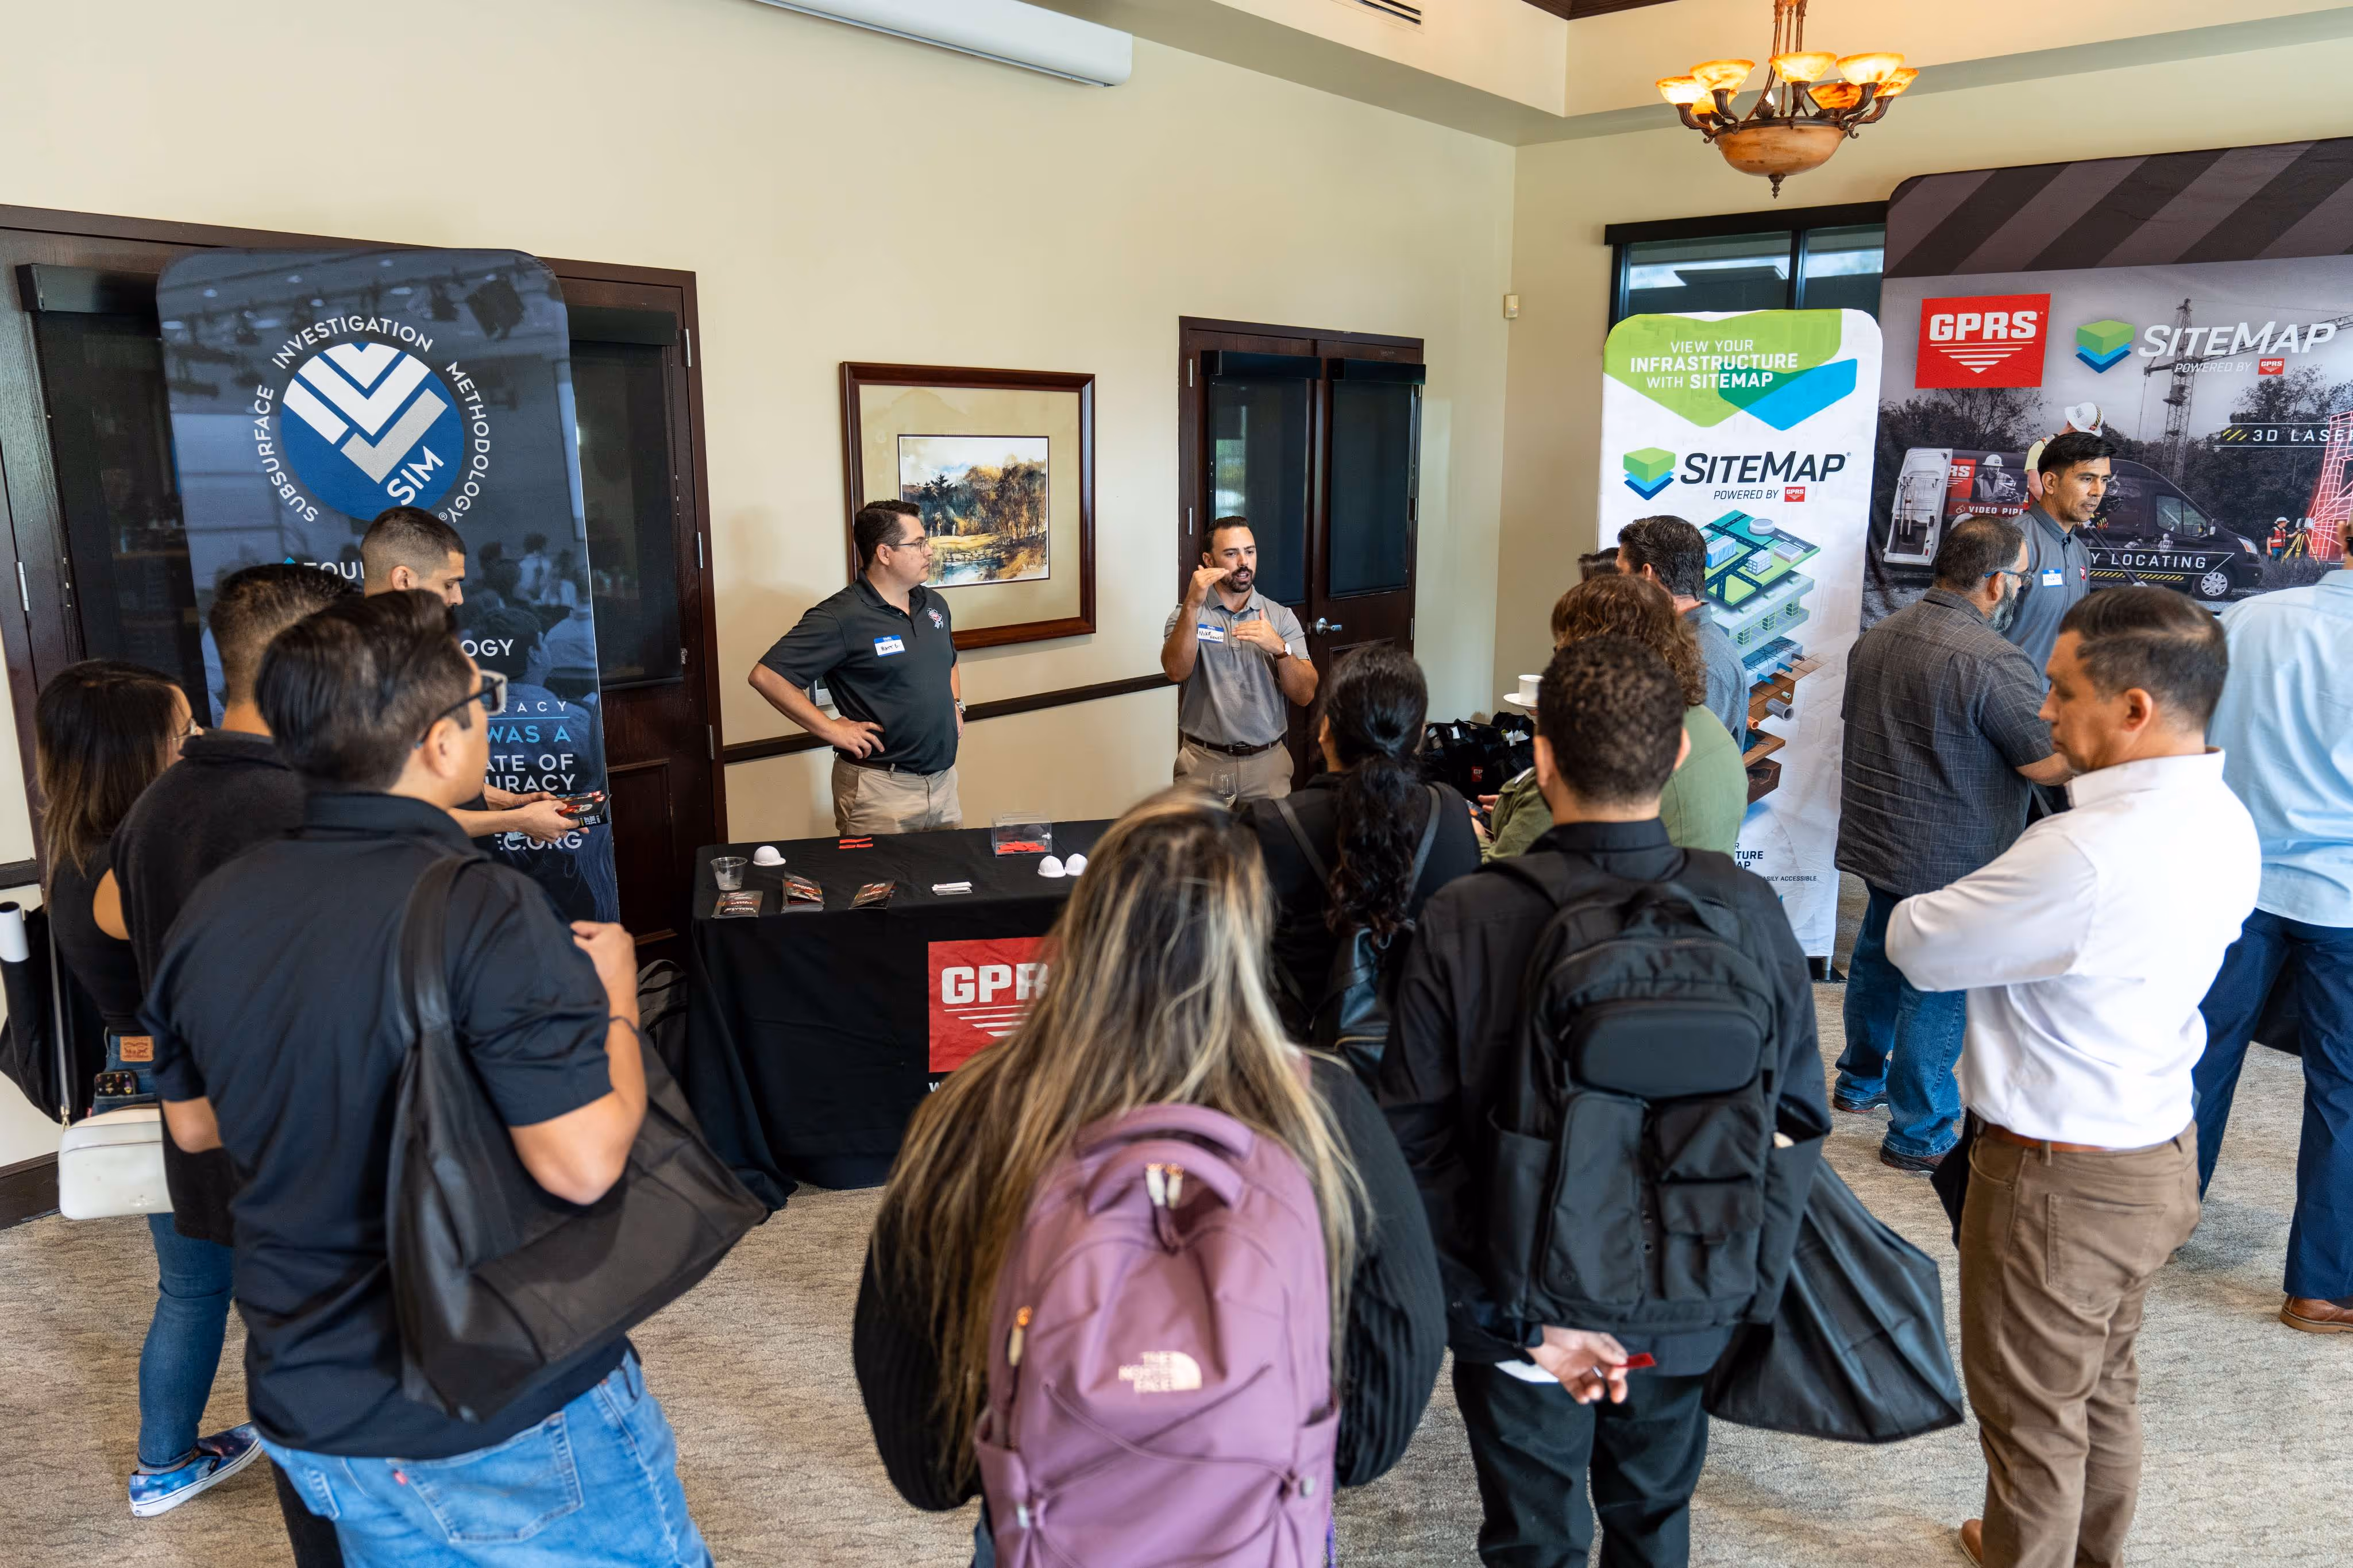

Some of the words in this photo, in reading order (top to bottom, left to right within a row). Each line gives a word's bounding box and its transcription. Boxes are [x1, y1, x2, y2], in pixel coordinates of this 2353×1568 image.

[1929, 311, 2038, 341] GPRS
[272, 315, 433, 369] INVESTIGATION
[1671, 341, 1708, 353] VIEW
[1715, 339, 1753, 352] YOUR
[1630, 353, 1798, 372] INFRASTRUCTURE
[2174, 362, 2233, 373] POWERED
[2236, 362, 2252, 372] BY
[1647, 377, 1683, 388] WITH
[1689, 372, 1773, 389] SITEMAP
[2252, 430, 2278, 442] 3D
[254, 384, 318, 522] SUBSURFACE
[387, 446, 444, 505] SIM
[1714, 489, 1762, 500] POWERED
[1766, 489, 1779, 499] BY
[1969, 506, 1997, 514] VIDEO
[2111, 553, 2206, 569] LOCATING
[304, 562, 364, 579] OU
[502, 701, 566, 712] ACY
[487, 725, 539, 743] WAS
[554, 725, 571, 742] A
[539, 754, 573, 771] OF
[1736, 851, 1764, 859] TURE
